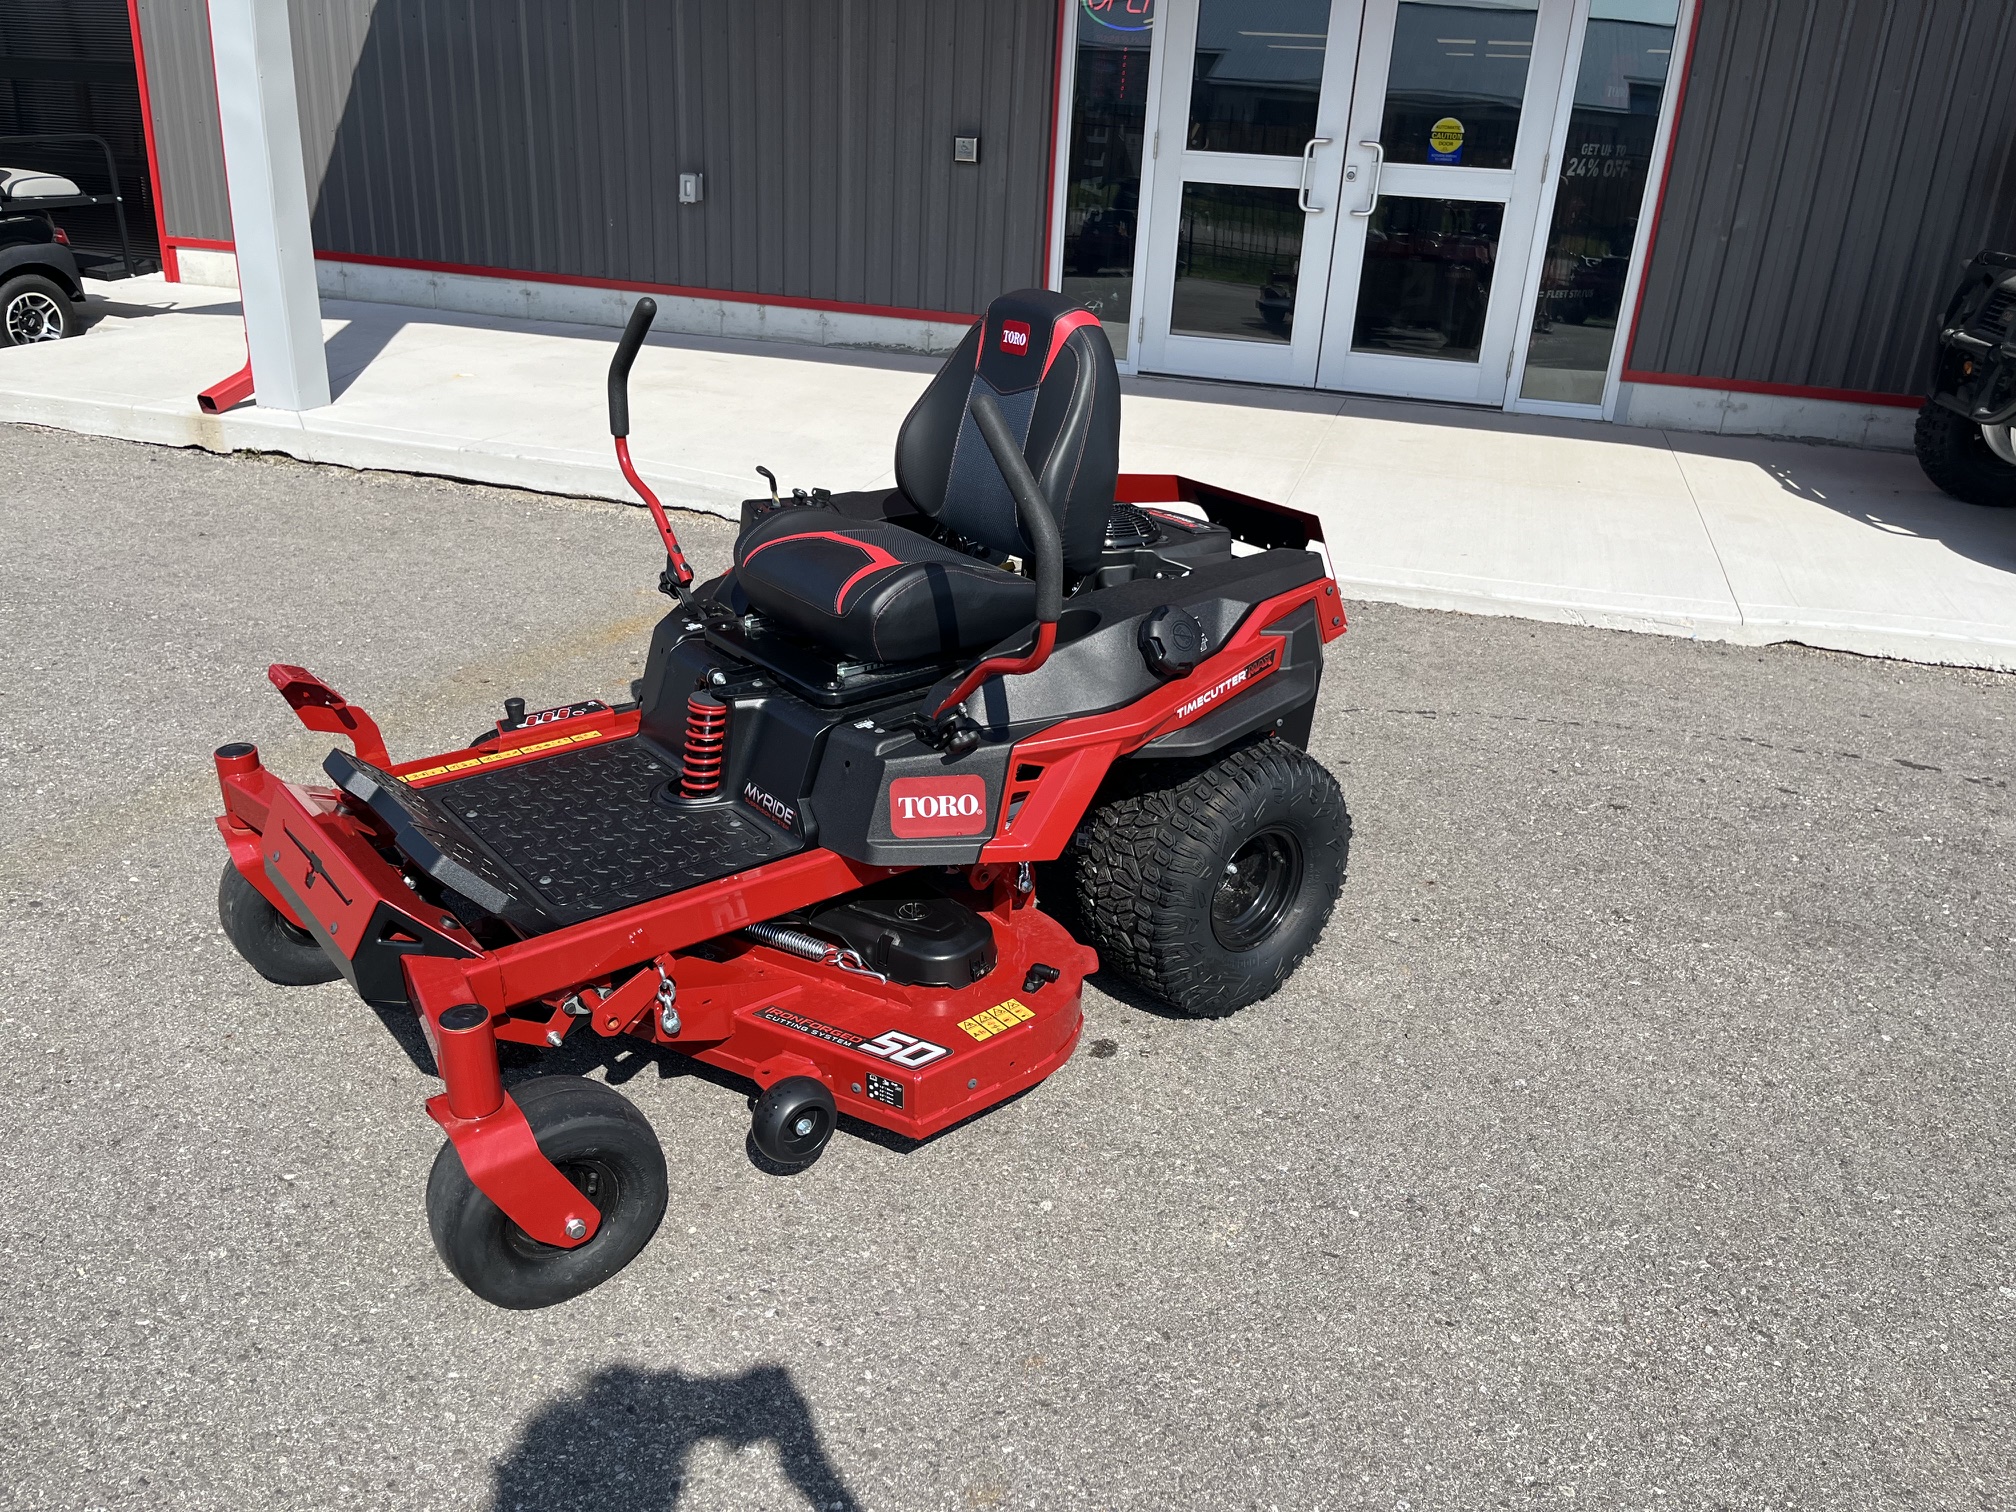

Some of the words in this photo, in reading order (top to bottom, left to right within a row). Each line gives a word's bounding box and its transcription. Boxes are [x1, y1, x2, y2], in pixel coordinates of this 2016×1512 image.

[1431, 132, 1463, 140] CAUTION
[1581, 143, 1600, 155] GET
[1616, 144, 1627, 157] TO
[1566, 157, 1600, 177] 24%
[1603, 159, 1631, 178] OFF
[1546, 289, 1569, 299] FLEET
[1003, 330, 1027, 346] TORO
[1177, 669, 1248, 719] TIMECUTTER
[1247, 654, 1273, 678] MAX
[765, 1006, 863, 1044] IRONFORGED
[765, 1014, 809, 1032] CUTTING
[811, 1030, 852, 1047] SYSTEM
[857, 1030, 948, 1068] 50
